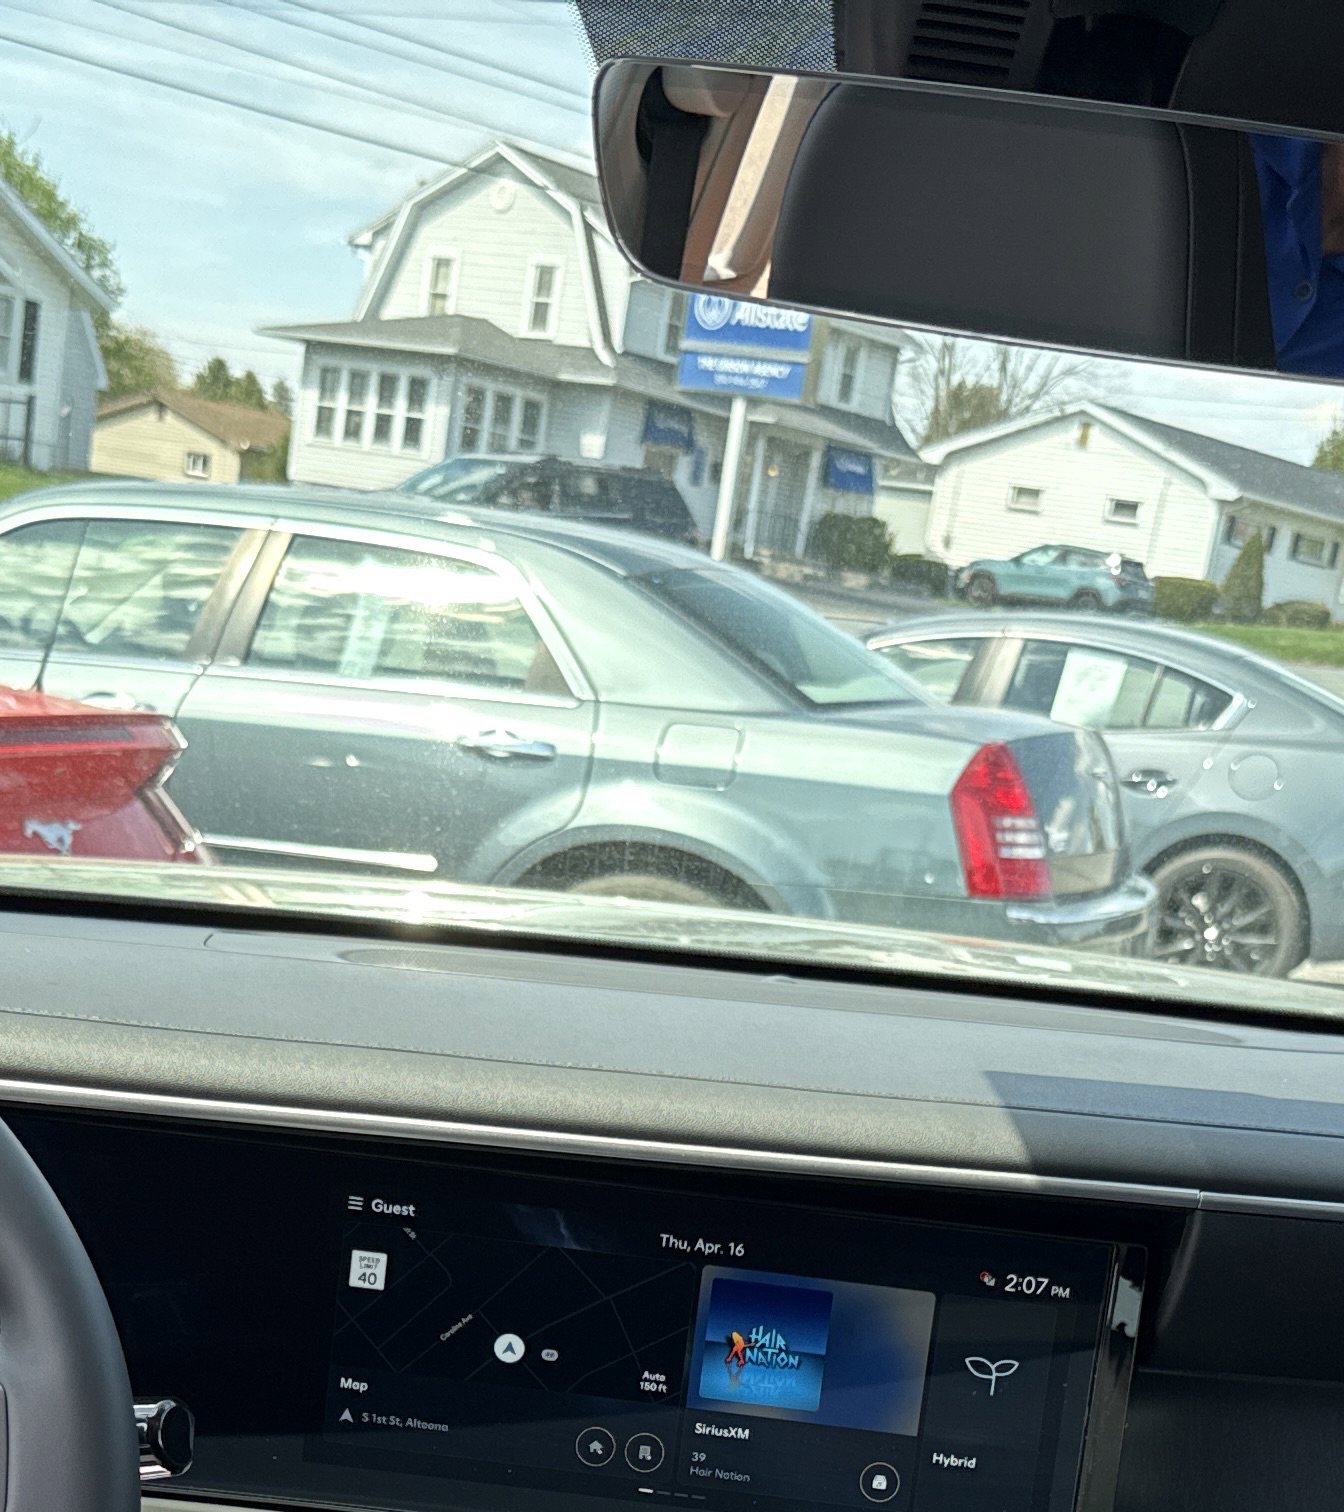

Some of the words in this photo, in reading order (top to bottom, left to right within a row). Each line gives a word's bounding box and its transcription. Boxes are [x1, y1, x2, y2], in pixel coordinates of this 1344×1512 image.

[371, 1199, 416, 1217] Guest
[660, 1234, 690, 1252] Thu,
[694, 1238, 723, 1256] Apr.
[728, 1242, 745, 1257] 16
[358, 1272, 377, 1285] 40
[1004, 1274, 1049, 1294] 2:07
[1051, 1286, 1070, 1298] PM
[749, 1325, 786, 1350] HAIR
[745, 1348, 799, 1368] NATION
[642, 1371, 666, 1381] Auto
[340, 1377, 368, 1393] Map
[640, 1382, 657, 1391] 150
[657, 1383, 668, 1393] ft
[371, 1413, 387, 1425] 1st
[406, 1417, 449, 1432] Altoona
[694, 1422, 750, 1440] SiriusXM
[691, 1451, 706, 1462] 39
[932, 1453, 977, 1470] Hybrid
[689, 1465, 712, 1477] Hair
[715, 1468, 751, 1482] Nation
